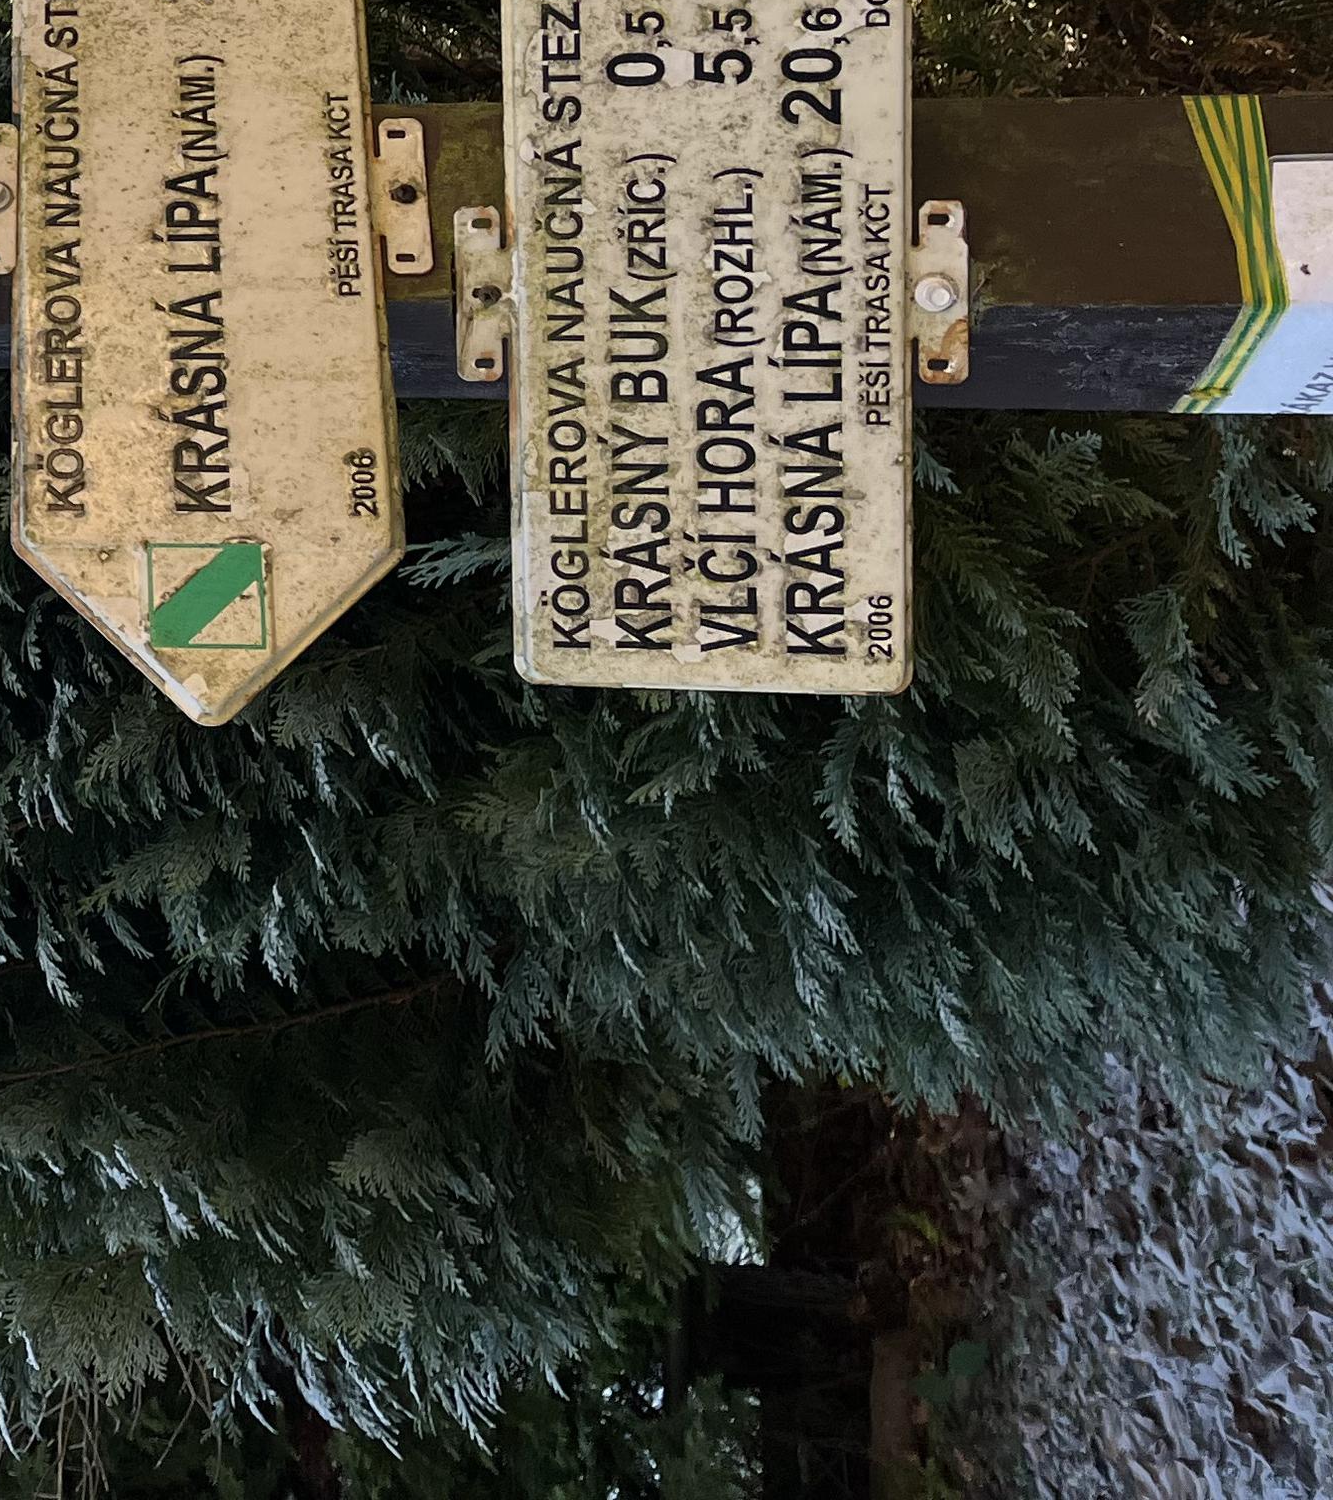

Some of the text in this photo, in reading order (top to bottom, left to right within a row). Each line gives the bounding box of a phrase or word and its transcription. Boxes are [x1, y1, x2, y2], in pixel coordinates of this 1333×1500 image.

[36, 62, 82, 228] NAUČNÁ
[606, 11, 672, 87] 0,5
[694, 9, 761, 84] 5,5
[781, 8, 849, 126] 20,6
[152, 54, 232, 513] KRÁSNÁ LÍPA (NÁM.)
[326, 92, 361, 297] PĚŠÍ TRASA KČT
[533, 140, 587, 342] NAUČNÁ
[37, 239, 85, 513] KÖGLEROVA
[597, 152, 677, 651] KRÁSNÝ BUK (ZŘÍC.)
[767, 148, 853, 656] KRÁSNÁ LÍPA (NÁM.)
[859, 183, 892, 426] PĚŠÍ TRASA KČT
[351, 454, 378, 517] 2006
[542, 357, 592, 649] KÖGLEROVA
[684, 168, 765, 651] VLČÍ HORA (ROZHL.)
[869, 594, 893, 658] 2006
